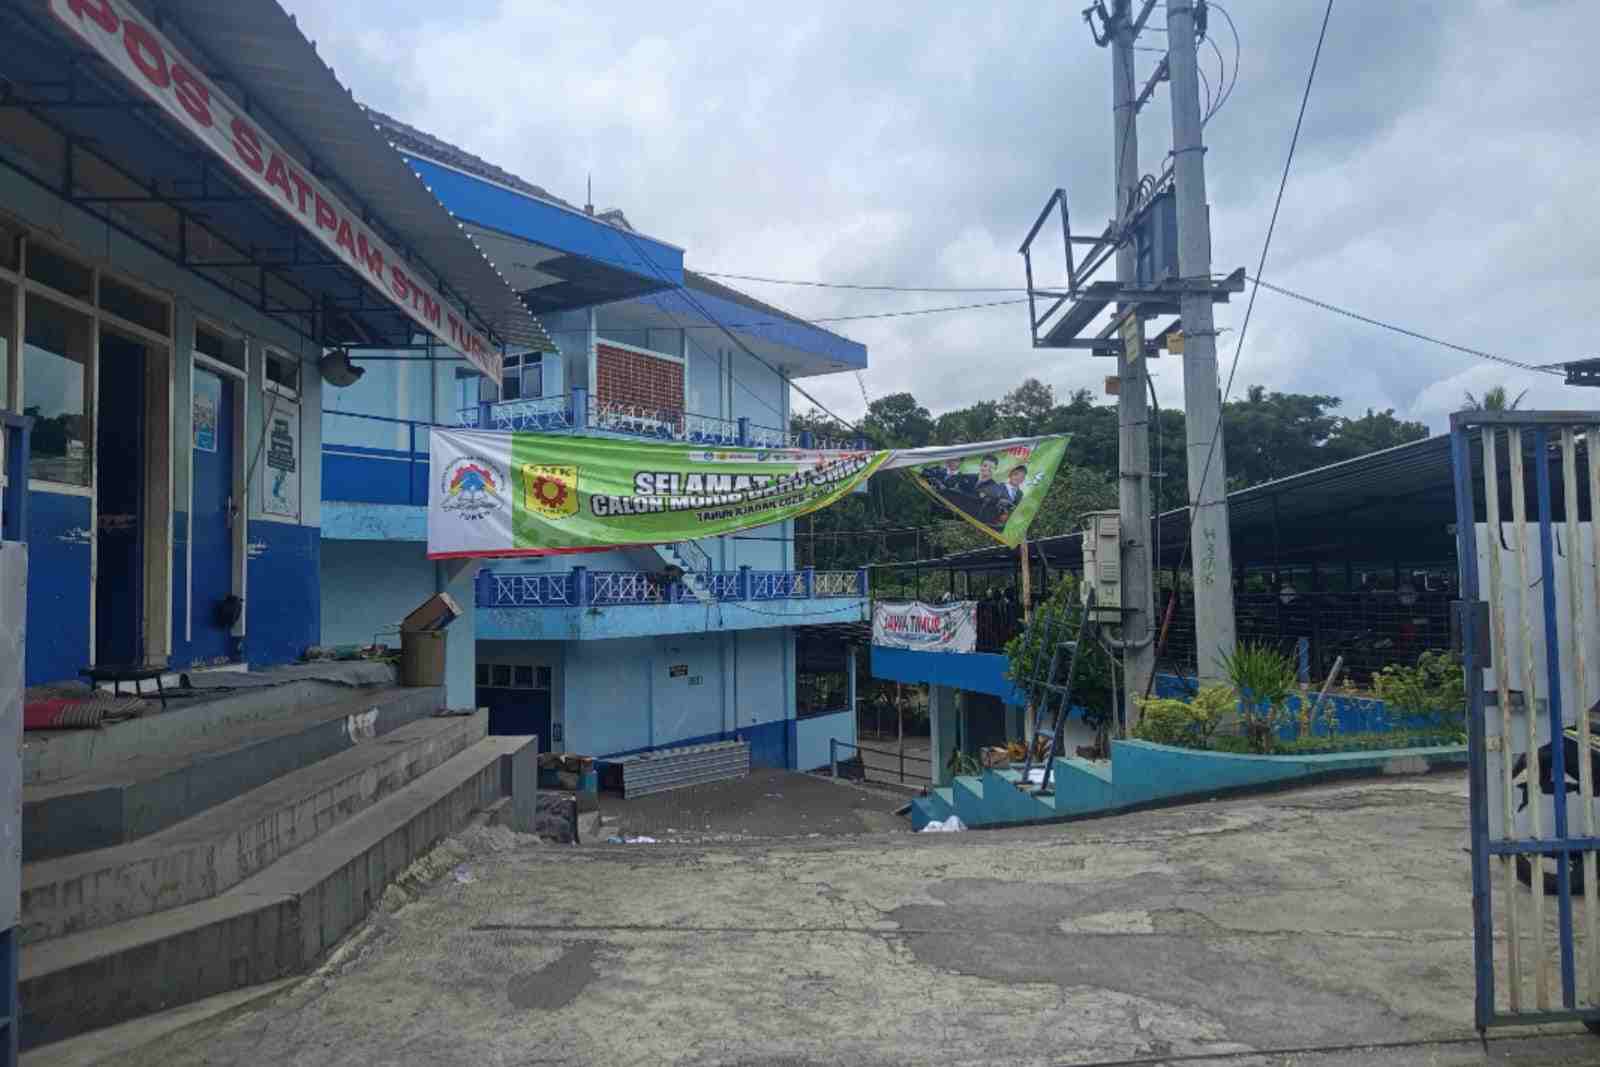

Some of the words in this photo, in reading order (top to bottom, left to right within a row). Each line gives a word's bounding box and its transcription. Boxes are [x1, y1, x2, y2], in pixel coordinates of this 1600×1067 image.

[66, 0, 213, 128] POS
[231, 117, 385, 278] SATPAM
[392, 266, 441, 328] STM
[633, 471, 773, 496] SELAMAT
[590, 494, 665, 517] CALON
